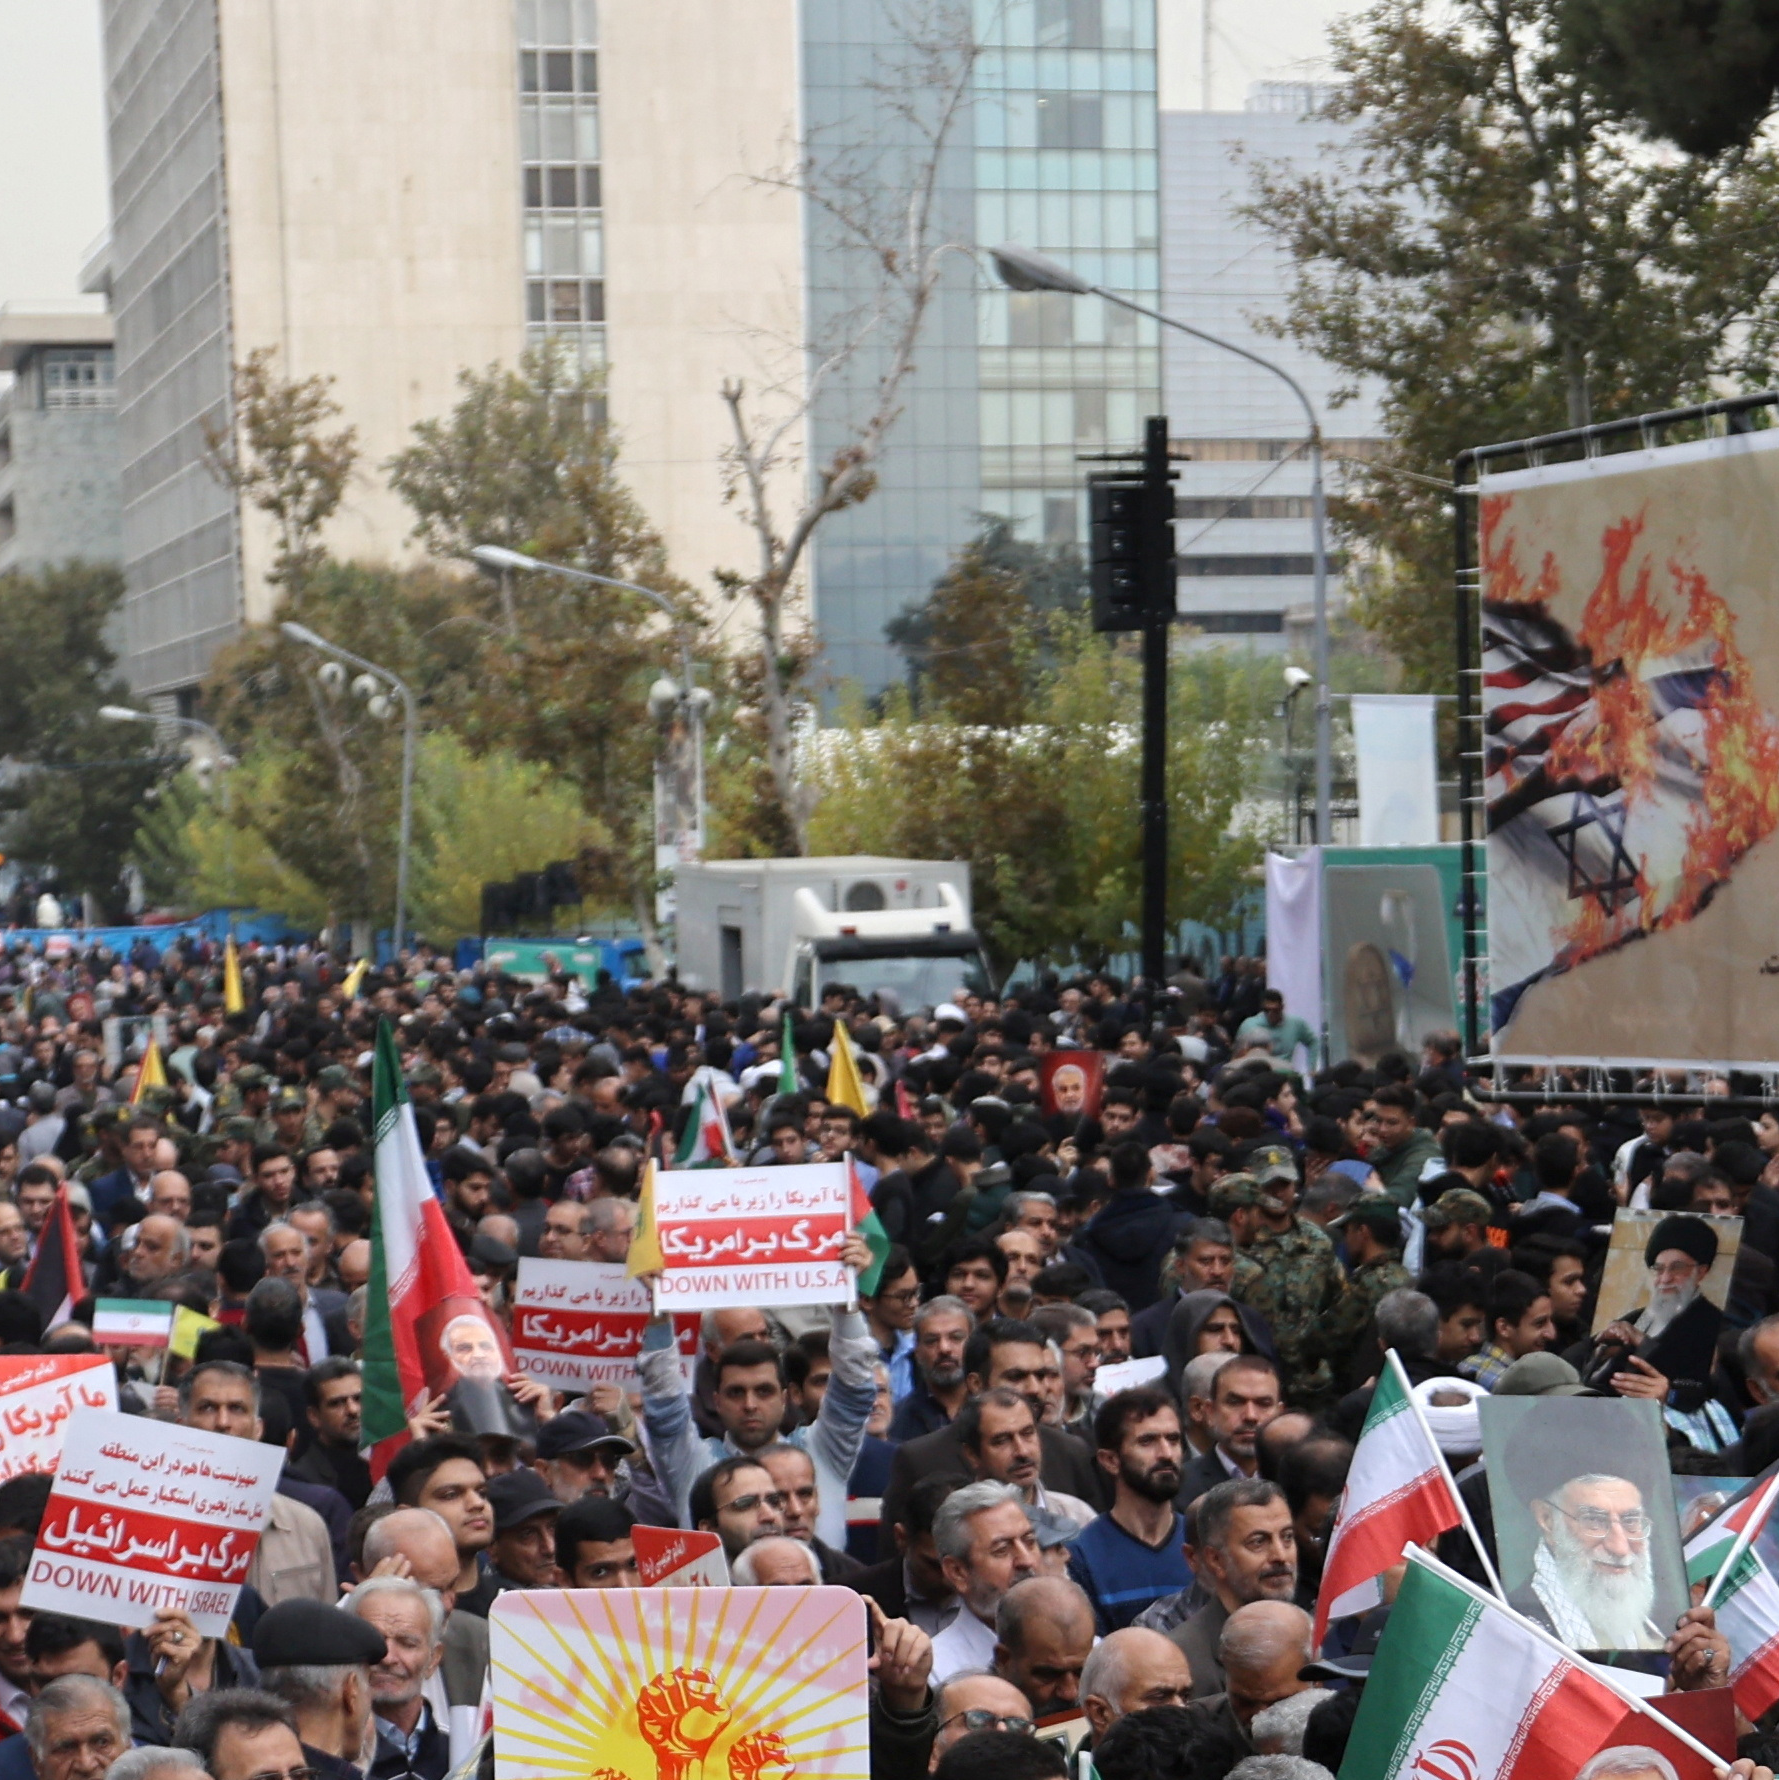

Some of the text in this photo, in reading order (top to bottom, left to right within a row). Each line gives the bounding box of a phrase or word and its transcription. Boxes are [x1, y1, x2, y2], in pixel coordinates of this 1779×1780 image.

[706, 1200, 727, 1212] می
[745, 1196, 764, 1211] زیر
[769, 1192, 782, 1209] را
[786, 1187, 828, 1208] آمریکا
[660, 1219, 845, 1261] مرگ بر امریکا
[660, 1269, 848, 1294] DOWN WITH U.S.A
[570, 1293, 591, 1303] می
[607, 1292, 626, 1306] زیر
[630, 1289, 641, 1306] را
[523, 1313, 601, 1348] امریکا
[596, 1327, 632, 1351] بر
[516, 1355, 636, 1380] DOWN WITH
[79, 1384, 107, 1407] ما
[3, 1383, 74, 1436] آمریکا
[99, 1442, 139, 1463] منطقه
[141, 1452, 165, 1470] این
[61, 1469, 94, 1484] کنند
[164, 1459, 180, 1475] در
[94, 1479, 117, 1493] می
[119, 1478, 149, 1498] عمل
[150, 1485, 195, 1505] استکبار
[195, 1496, 232, 1518] زنجیری
[43, 1507, 252, 1580] مرگ بر اسرائیل
[32, 1561, 230, 1615] DOWN WITH ISRAEL
